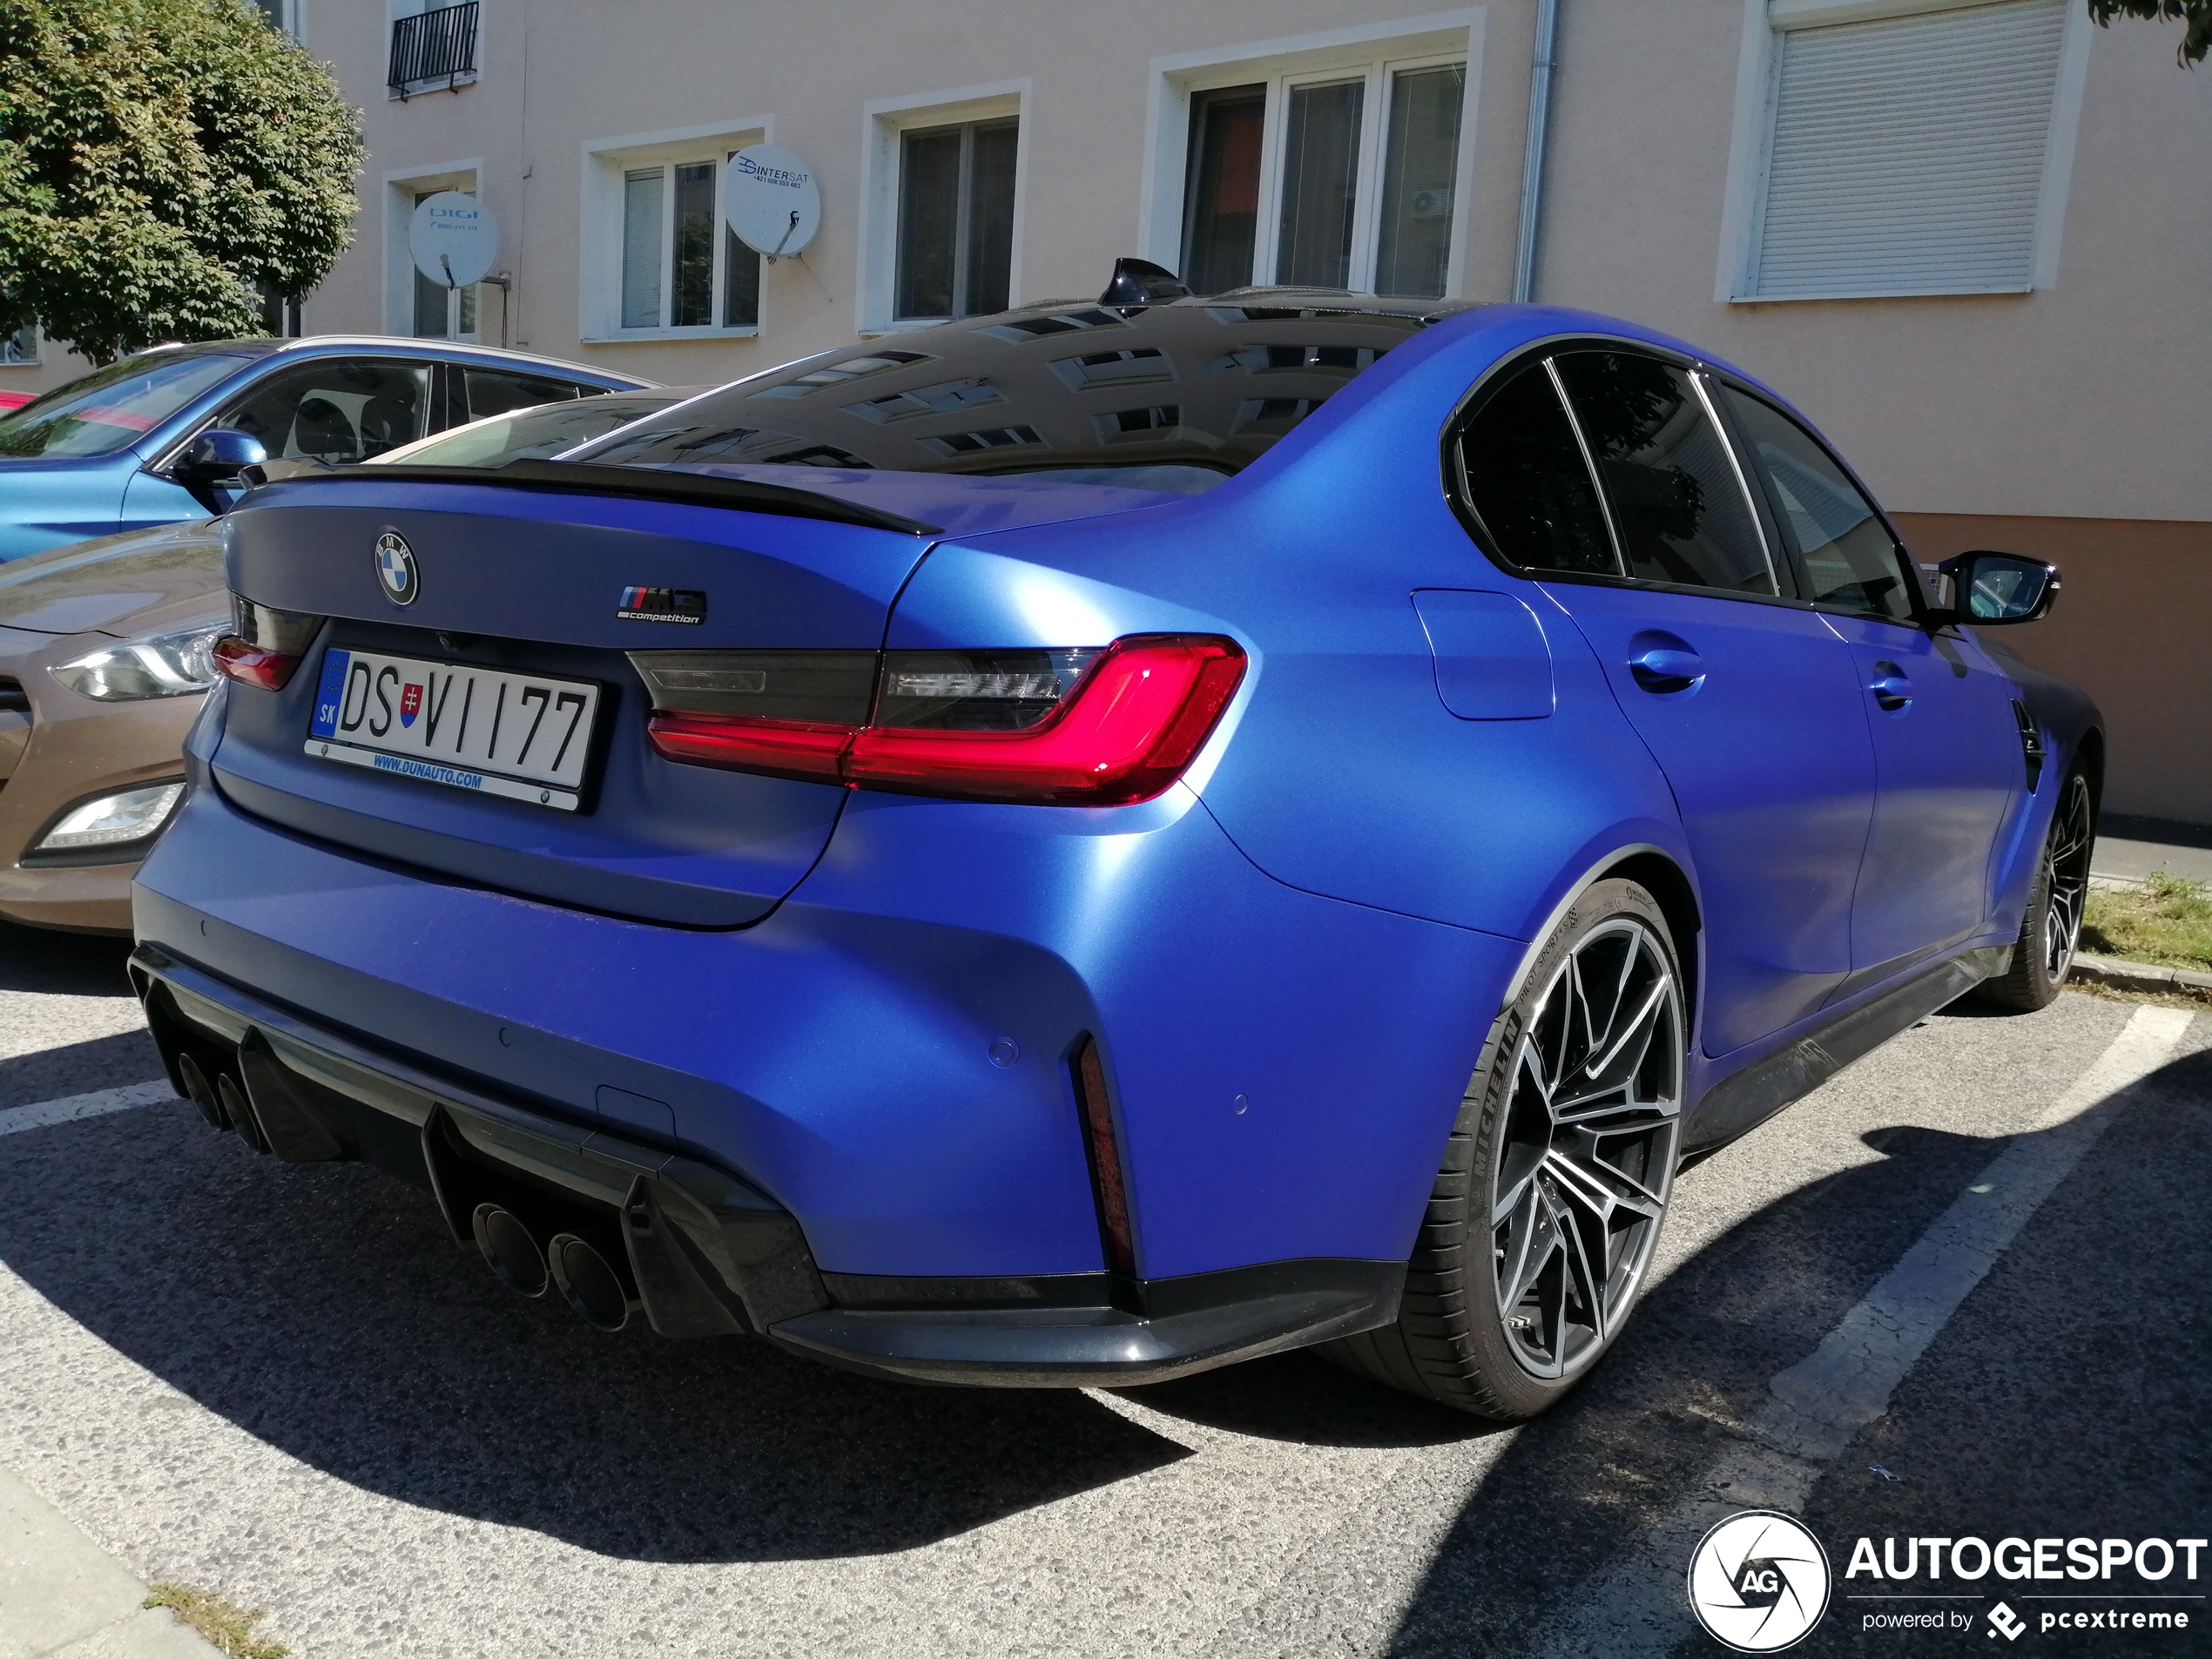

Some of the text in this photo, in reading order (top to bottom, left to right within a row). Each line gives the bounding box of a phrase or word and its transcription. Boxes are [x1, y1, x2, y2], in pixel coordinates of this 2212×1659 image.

[757, 165, 809, 184] INTERSAT
[430, 208, 478, 219] DIGI
[376, 536, 409, 560] BMW
[629, 612, 699, 624] competition
[341, 660, 399, 738] DS
[320, 704, 336, 725] SK
[374, 754, 482, 789] WWW.DUNAUTO.COM
[1520, 967, 1537, 1005] PILOT
[1474, 1017, 1521, 1177] MICHELIN
